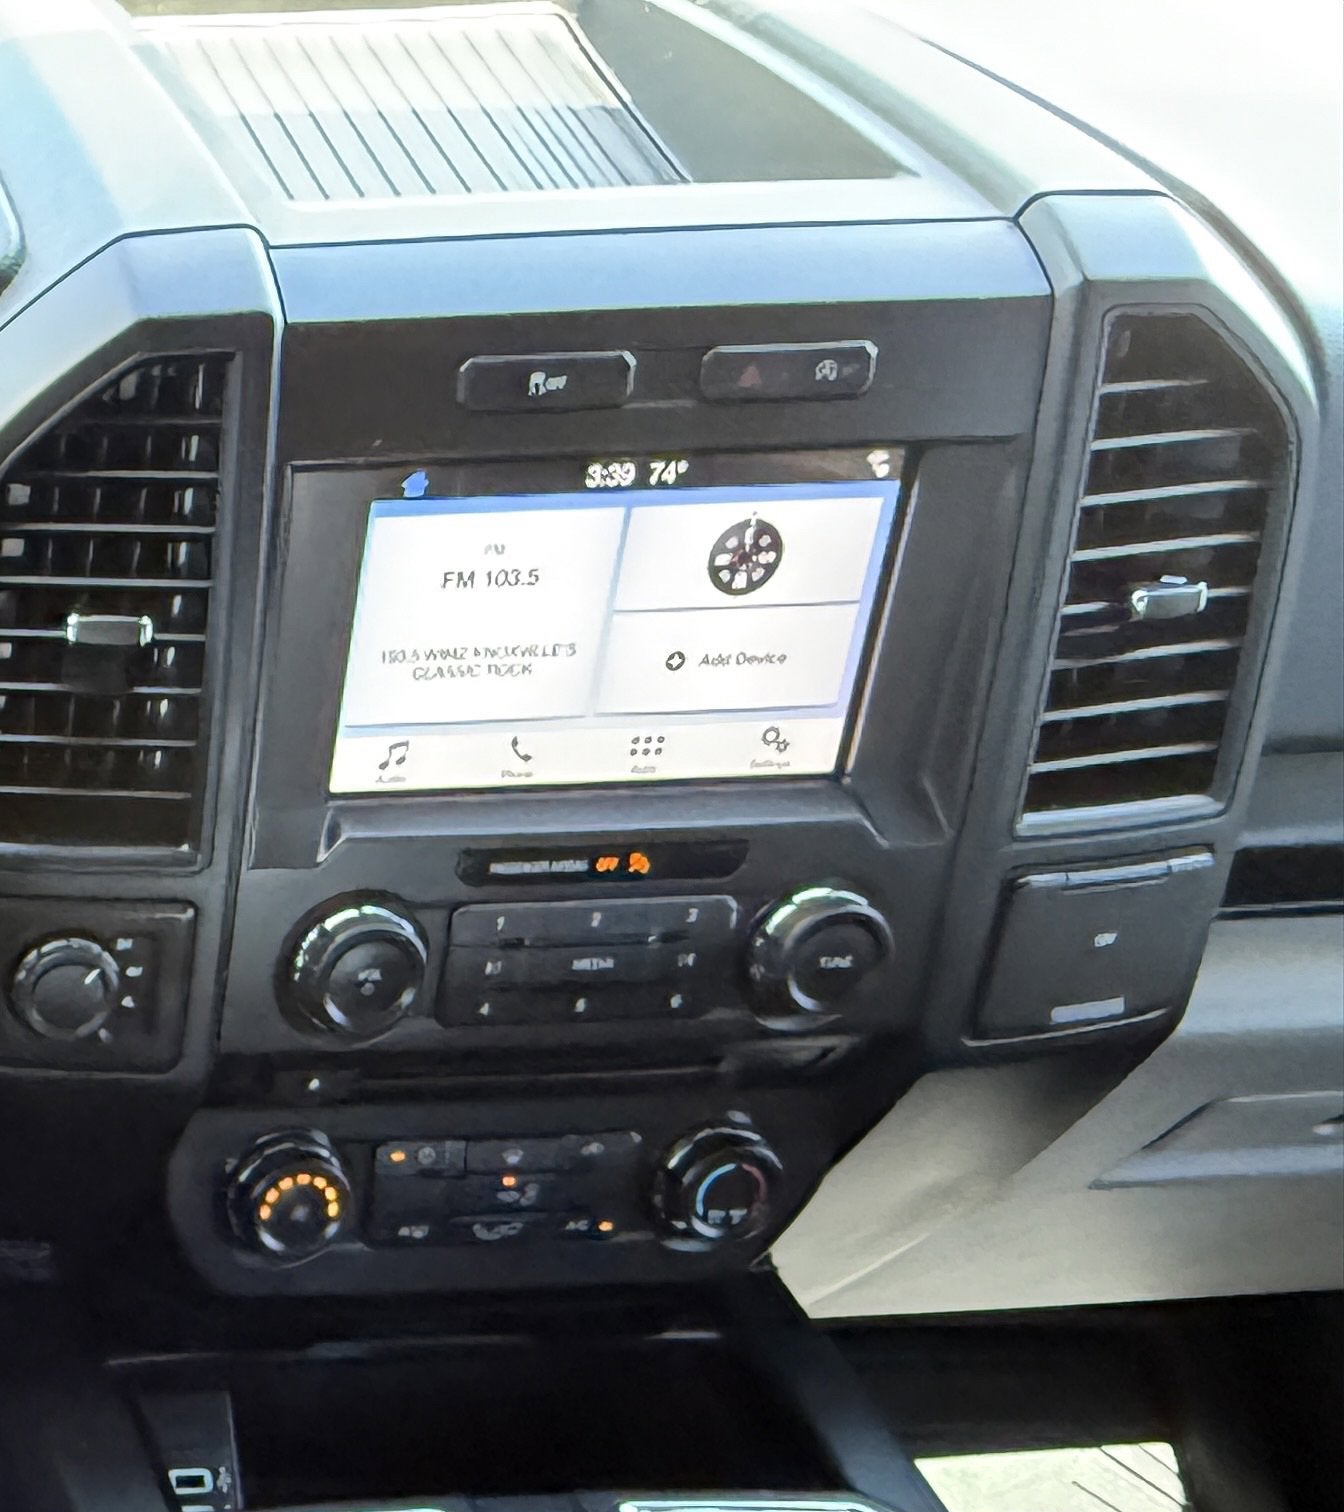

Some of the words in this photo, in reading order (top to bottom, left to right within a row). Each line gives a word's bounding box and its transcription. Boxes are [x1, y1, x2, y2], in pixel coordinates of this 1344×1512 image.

[440, 571, 476, 589] FM
[486, 568, 540, 588] 103.5
[698, 652, 731, 668] Add
